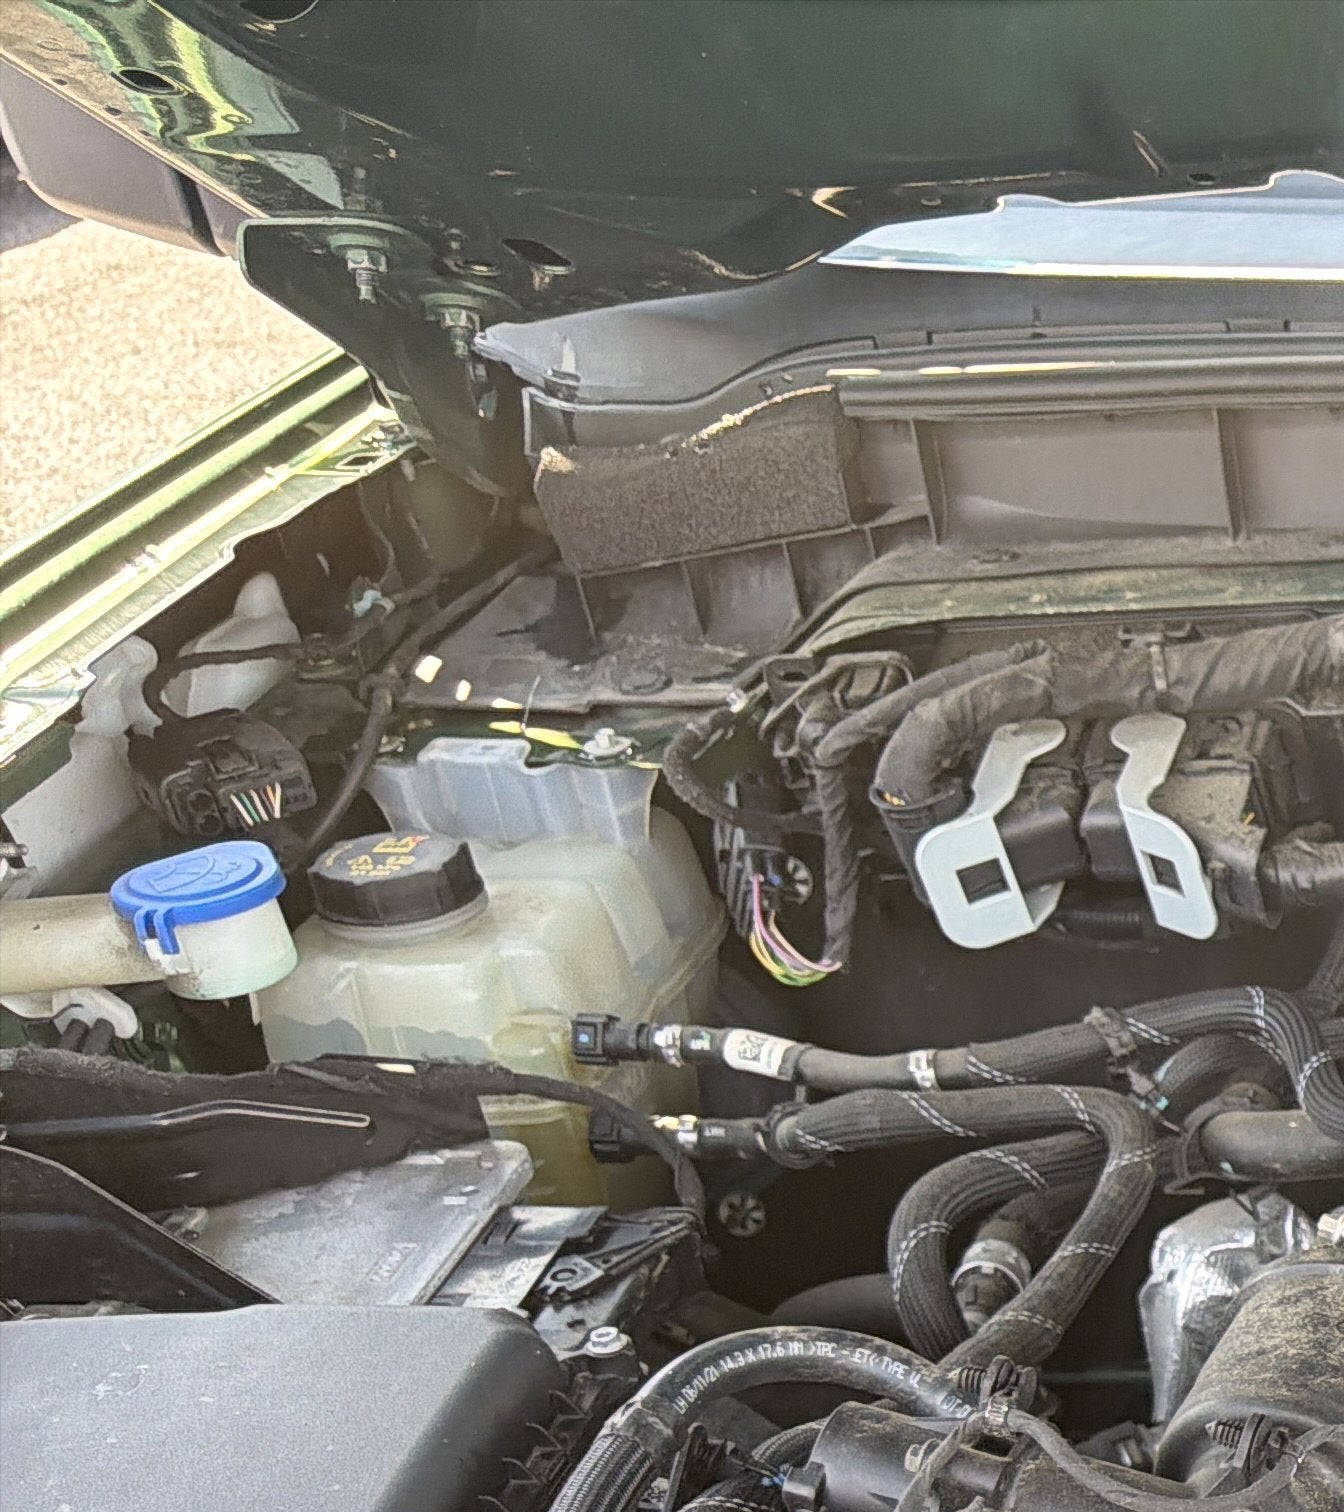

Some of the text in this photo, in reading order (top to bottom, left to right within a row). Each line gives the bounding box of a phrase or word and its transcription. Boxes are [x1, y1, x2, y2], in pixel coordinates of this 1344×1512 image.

[720, 1351, 745, 1372] 14.3
[758, 1341, 785, 1359] 17.6
[881, 1355, 910, 1379] TYPE
